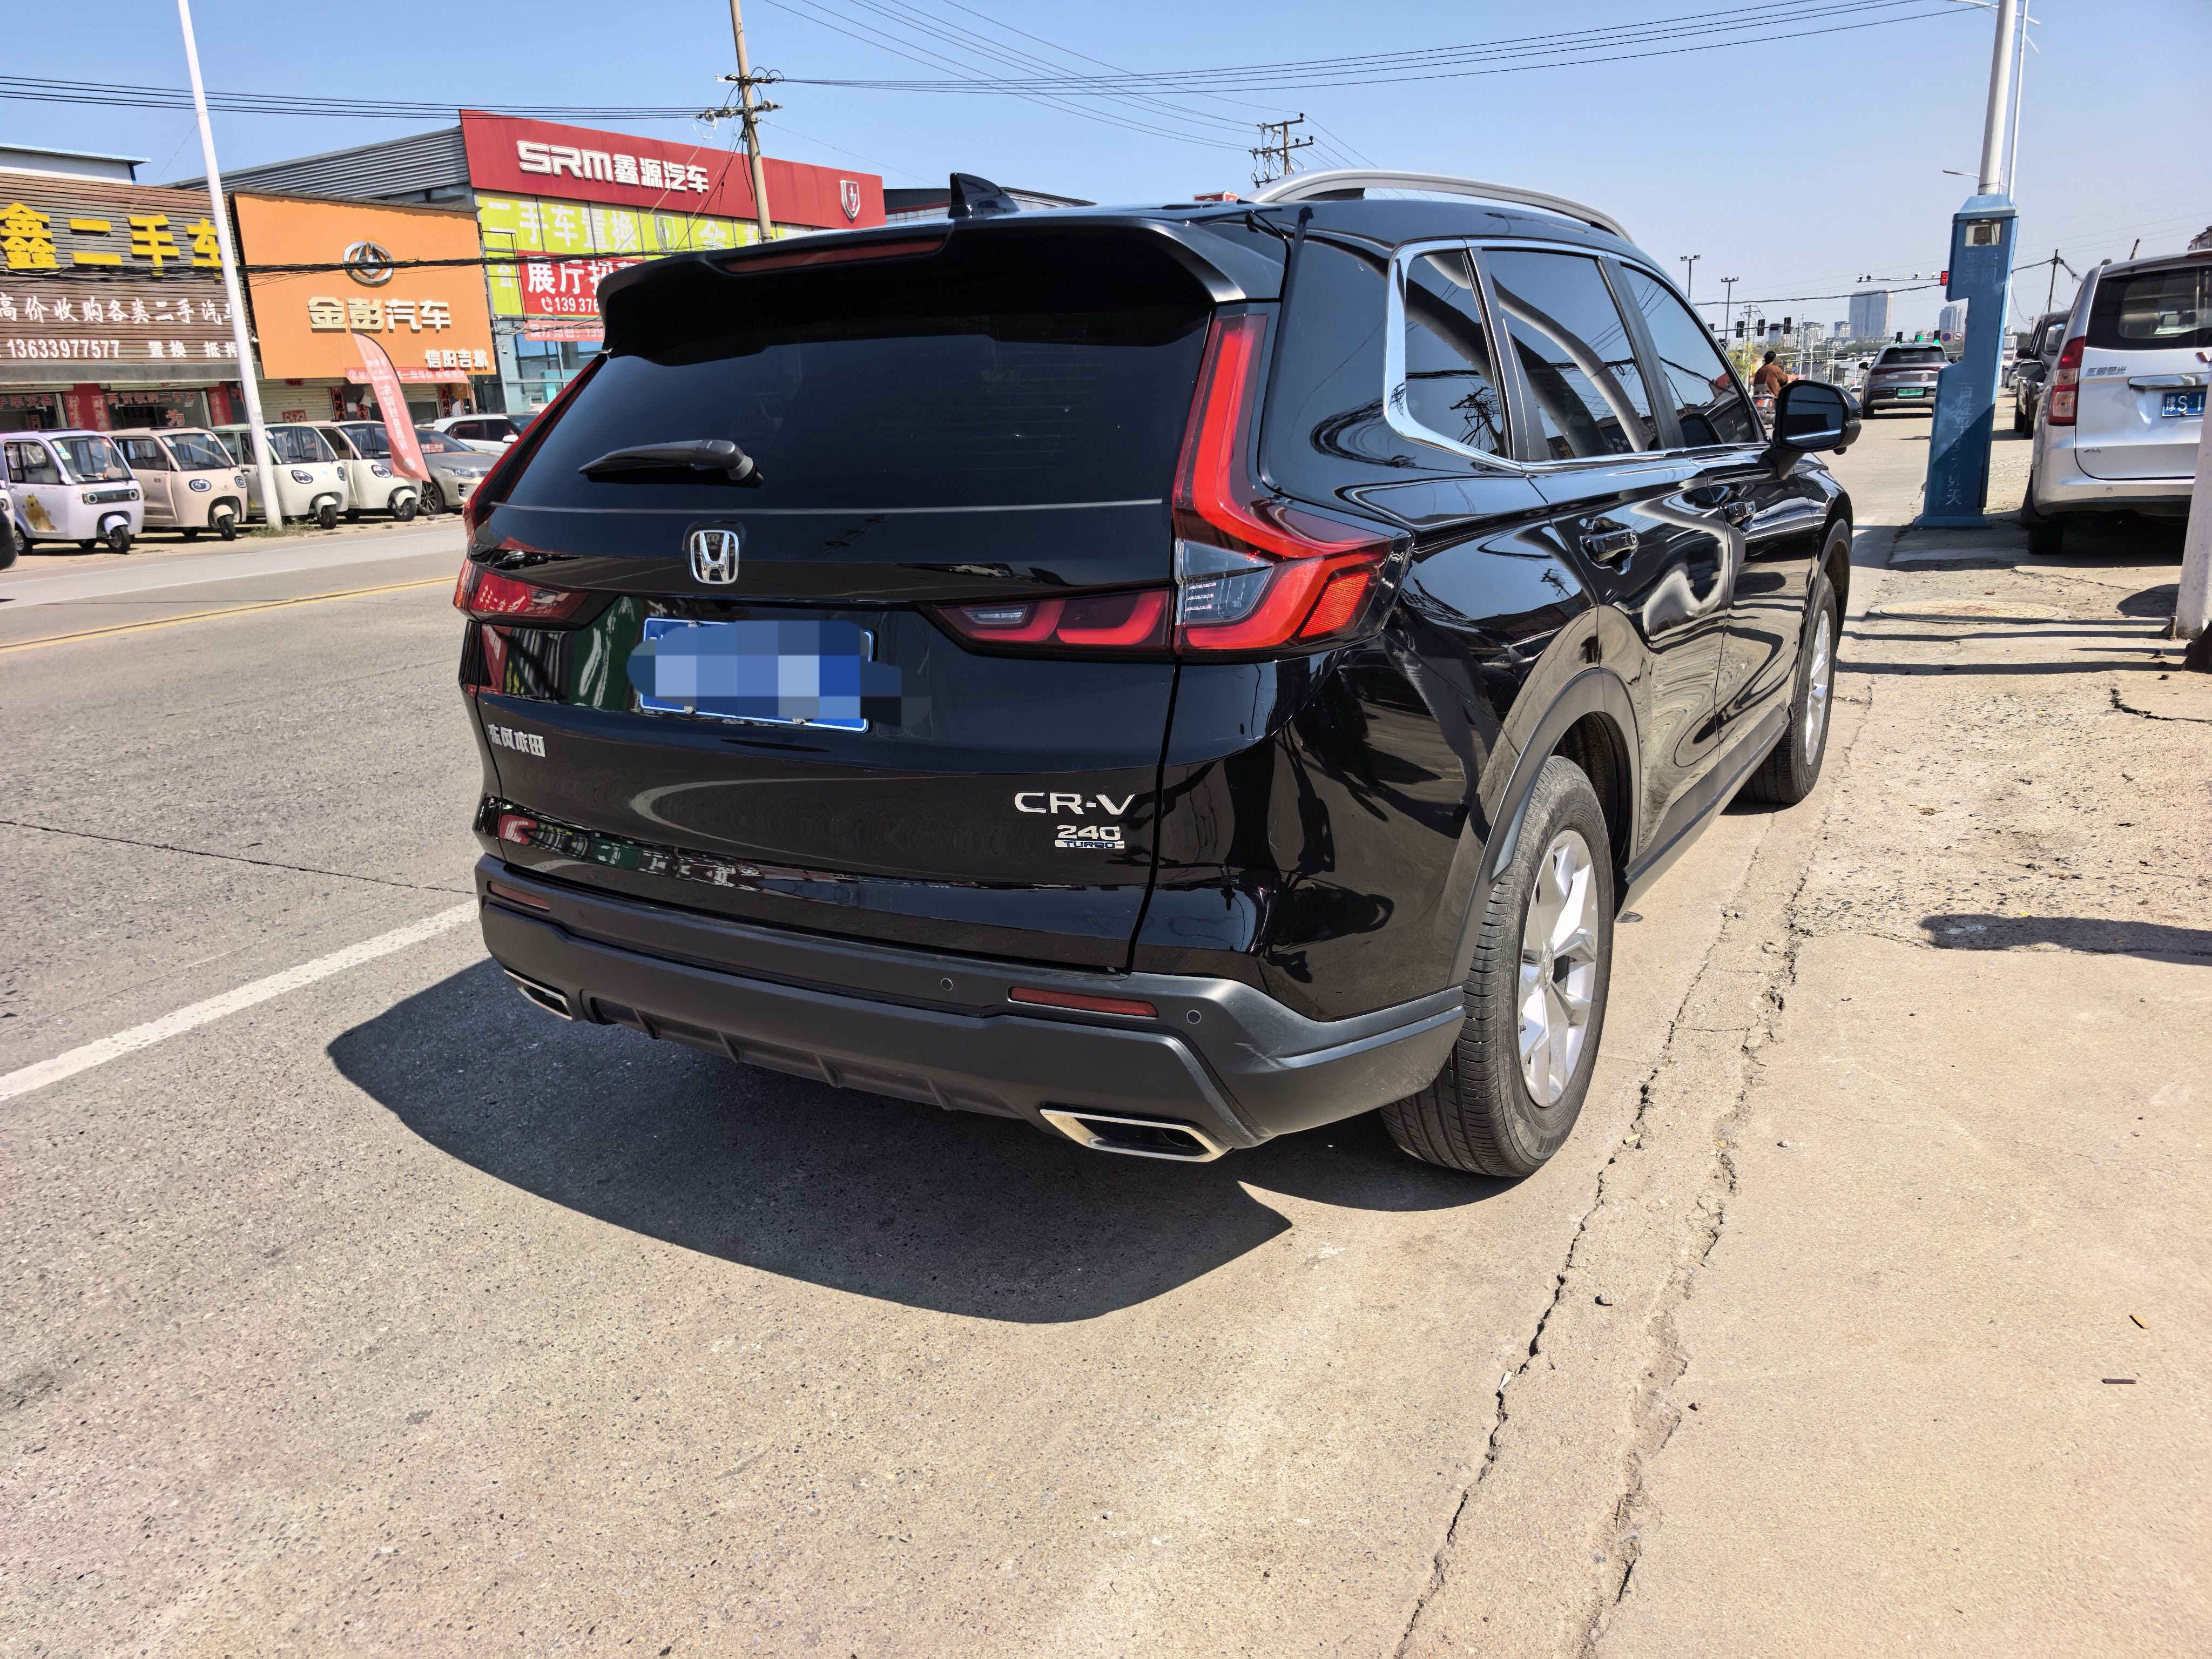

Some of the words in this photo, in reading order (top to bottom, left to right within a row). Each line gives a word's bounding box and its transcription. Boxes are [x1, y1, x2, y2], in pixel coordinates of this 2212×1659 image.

[517, 140, 613, 181] SRM
[612, 153, 709, 193] 鑫源汽车
[488, 200, 637, 250] 二手车置换
[528, 256, 638, 294] 展厅招
[307, 296, 451, 330] 金彭汽车
[7, 339, 120, 359] 13633977577
[148, 340, 186, 358] 置换
[488, 724, 545, 757] 东风本田
[1014, 791, 1135, 815] CR-V
[1057, 825, 1121, 840] 240
[1062, 840, 1116, 848] TURBO
